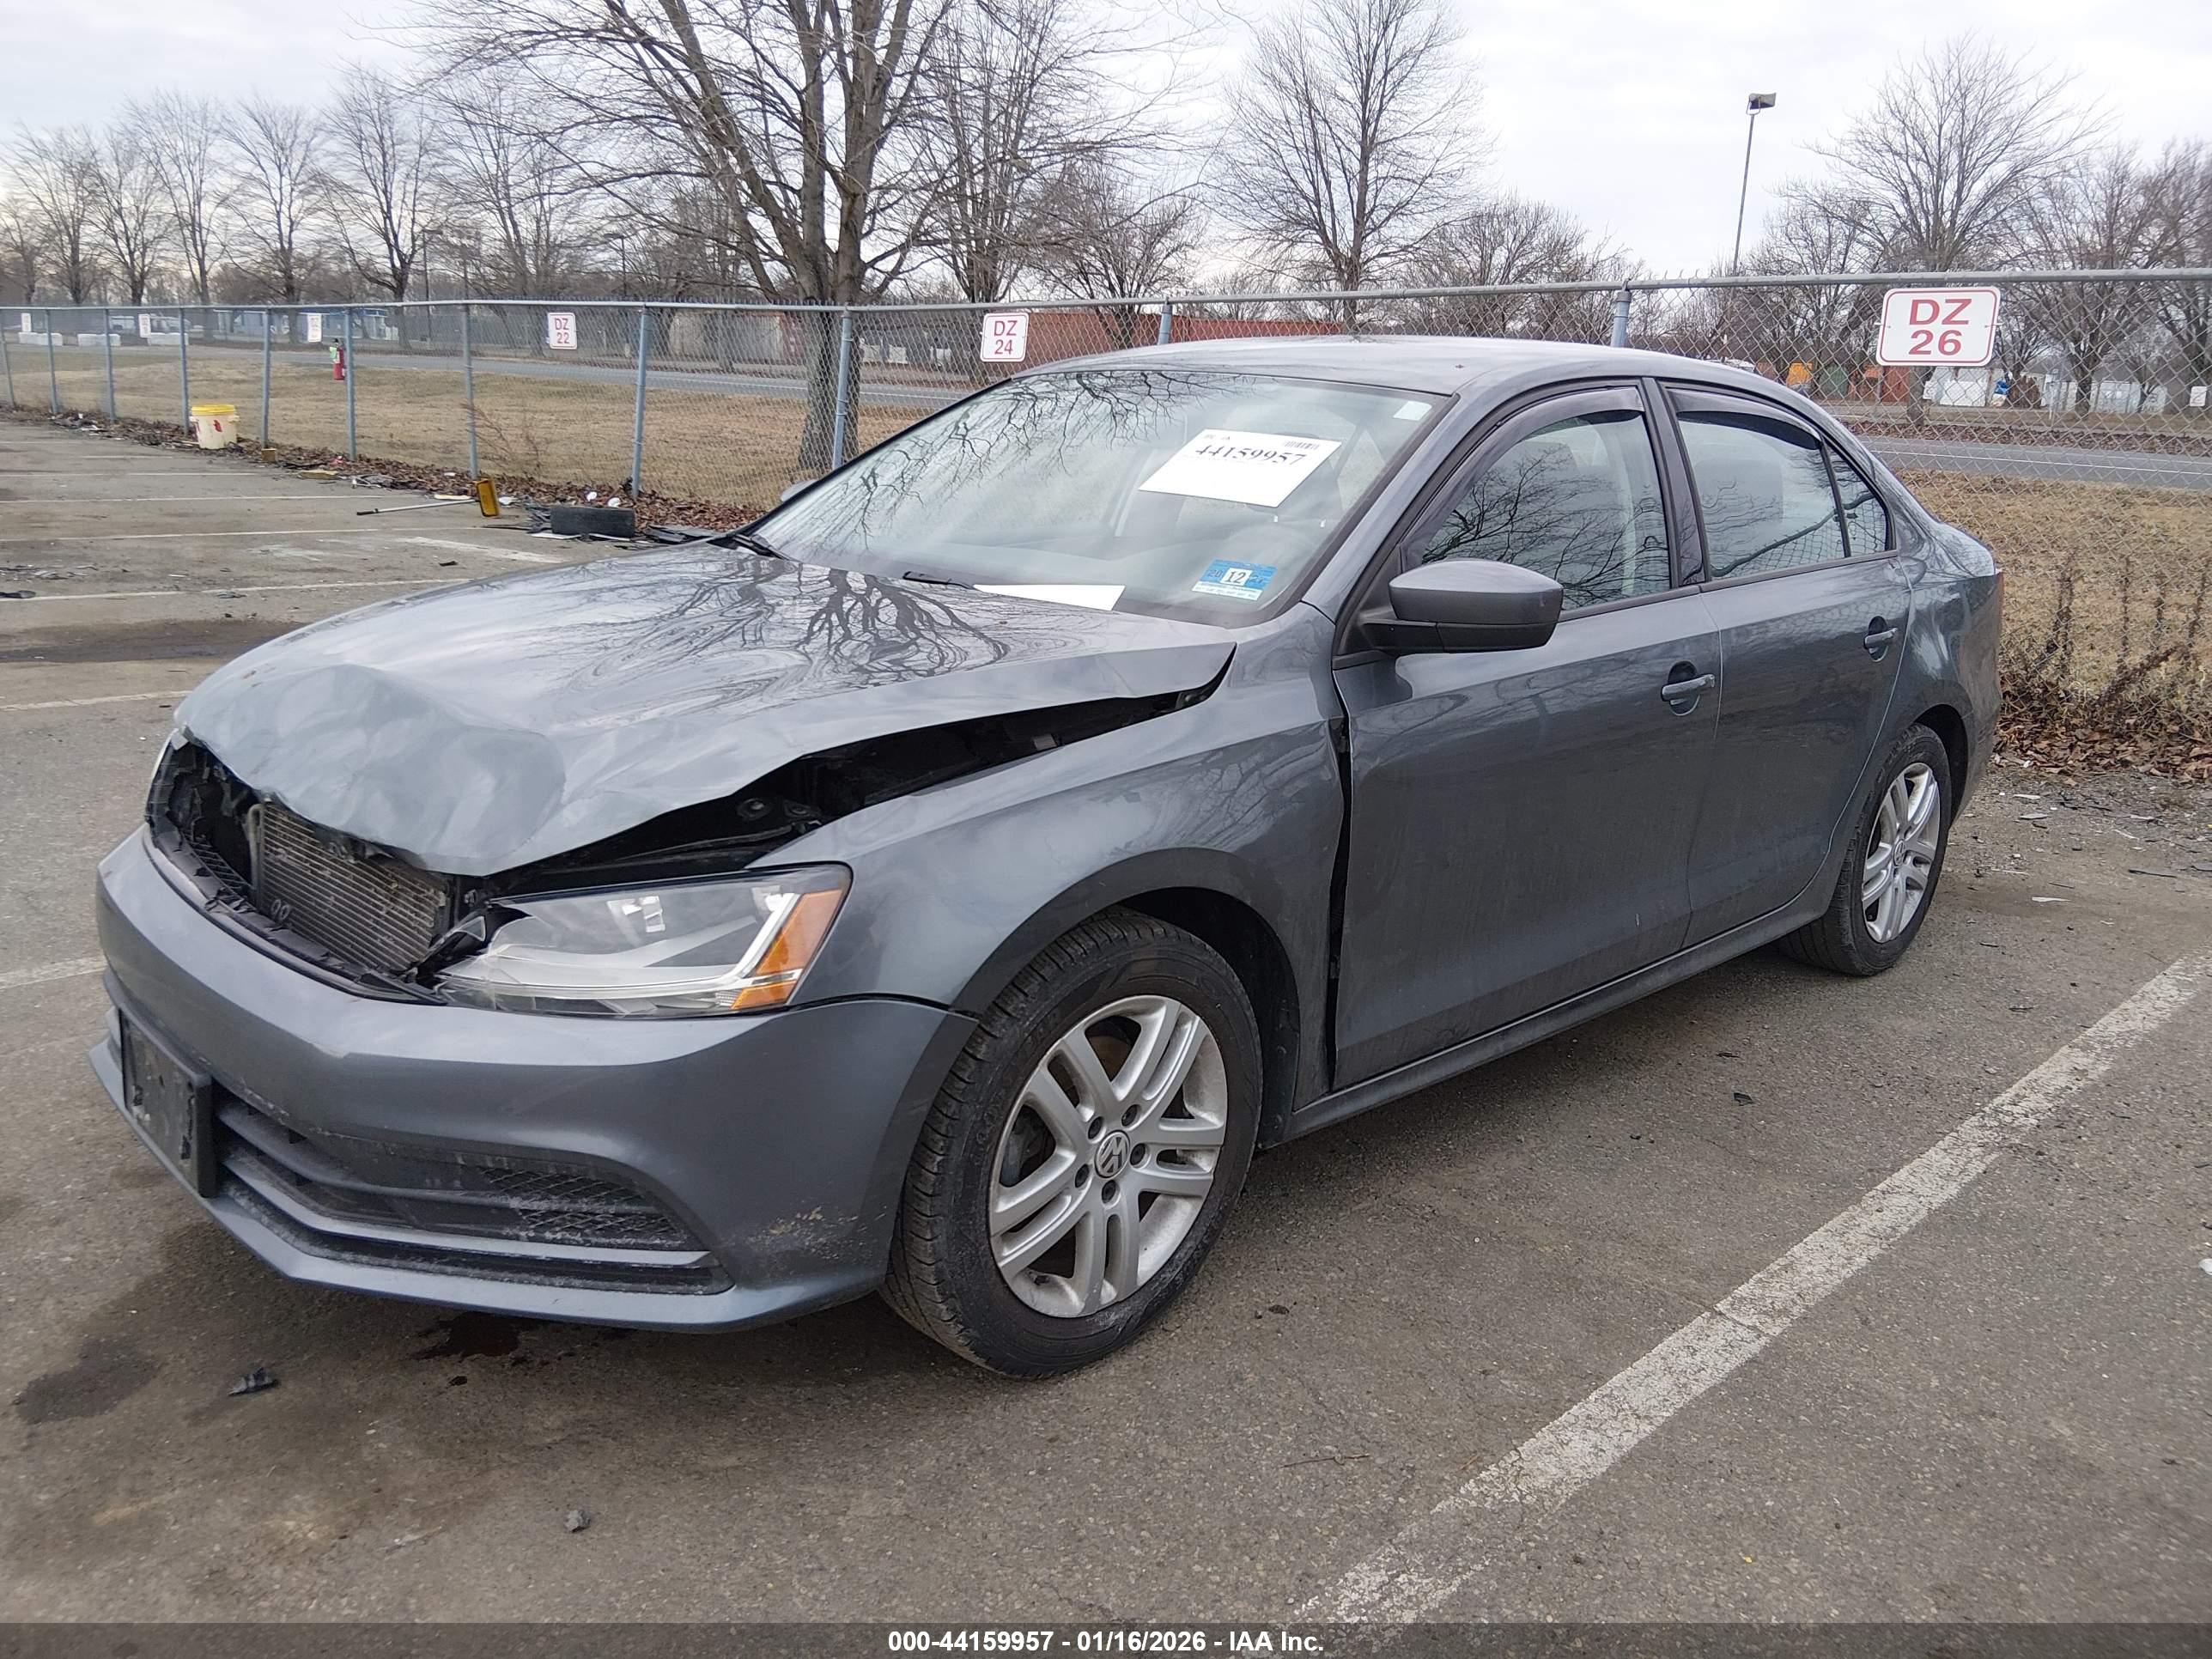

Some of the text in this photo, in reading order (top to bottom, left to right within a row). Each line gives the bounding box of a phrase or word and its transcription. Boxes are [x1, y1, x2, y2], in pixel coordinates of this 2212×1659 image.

[1909, 298, 1972, 325] DZ
[555, 318, 568, 331] DZ
[994, 320, 1018, 337] DZ
[556, 331, 570, 343] 22
[1908, 329, 1962, 356] 26
[994, 339, 1013, 355] 24
[1195, 445, 1307, 465] 44159957
[1224, 570, 1246, 583] 12
